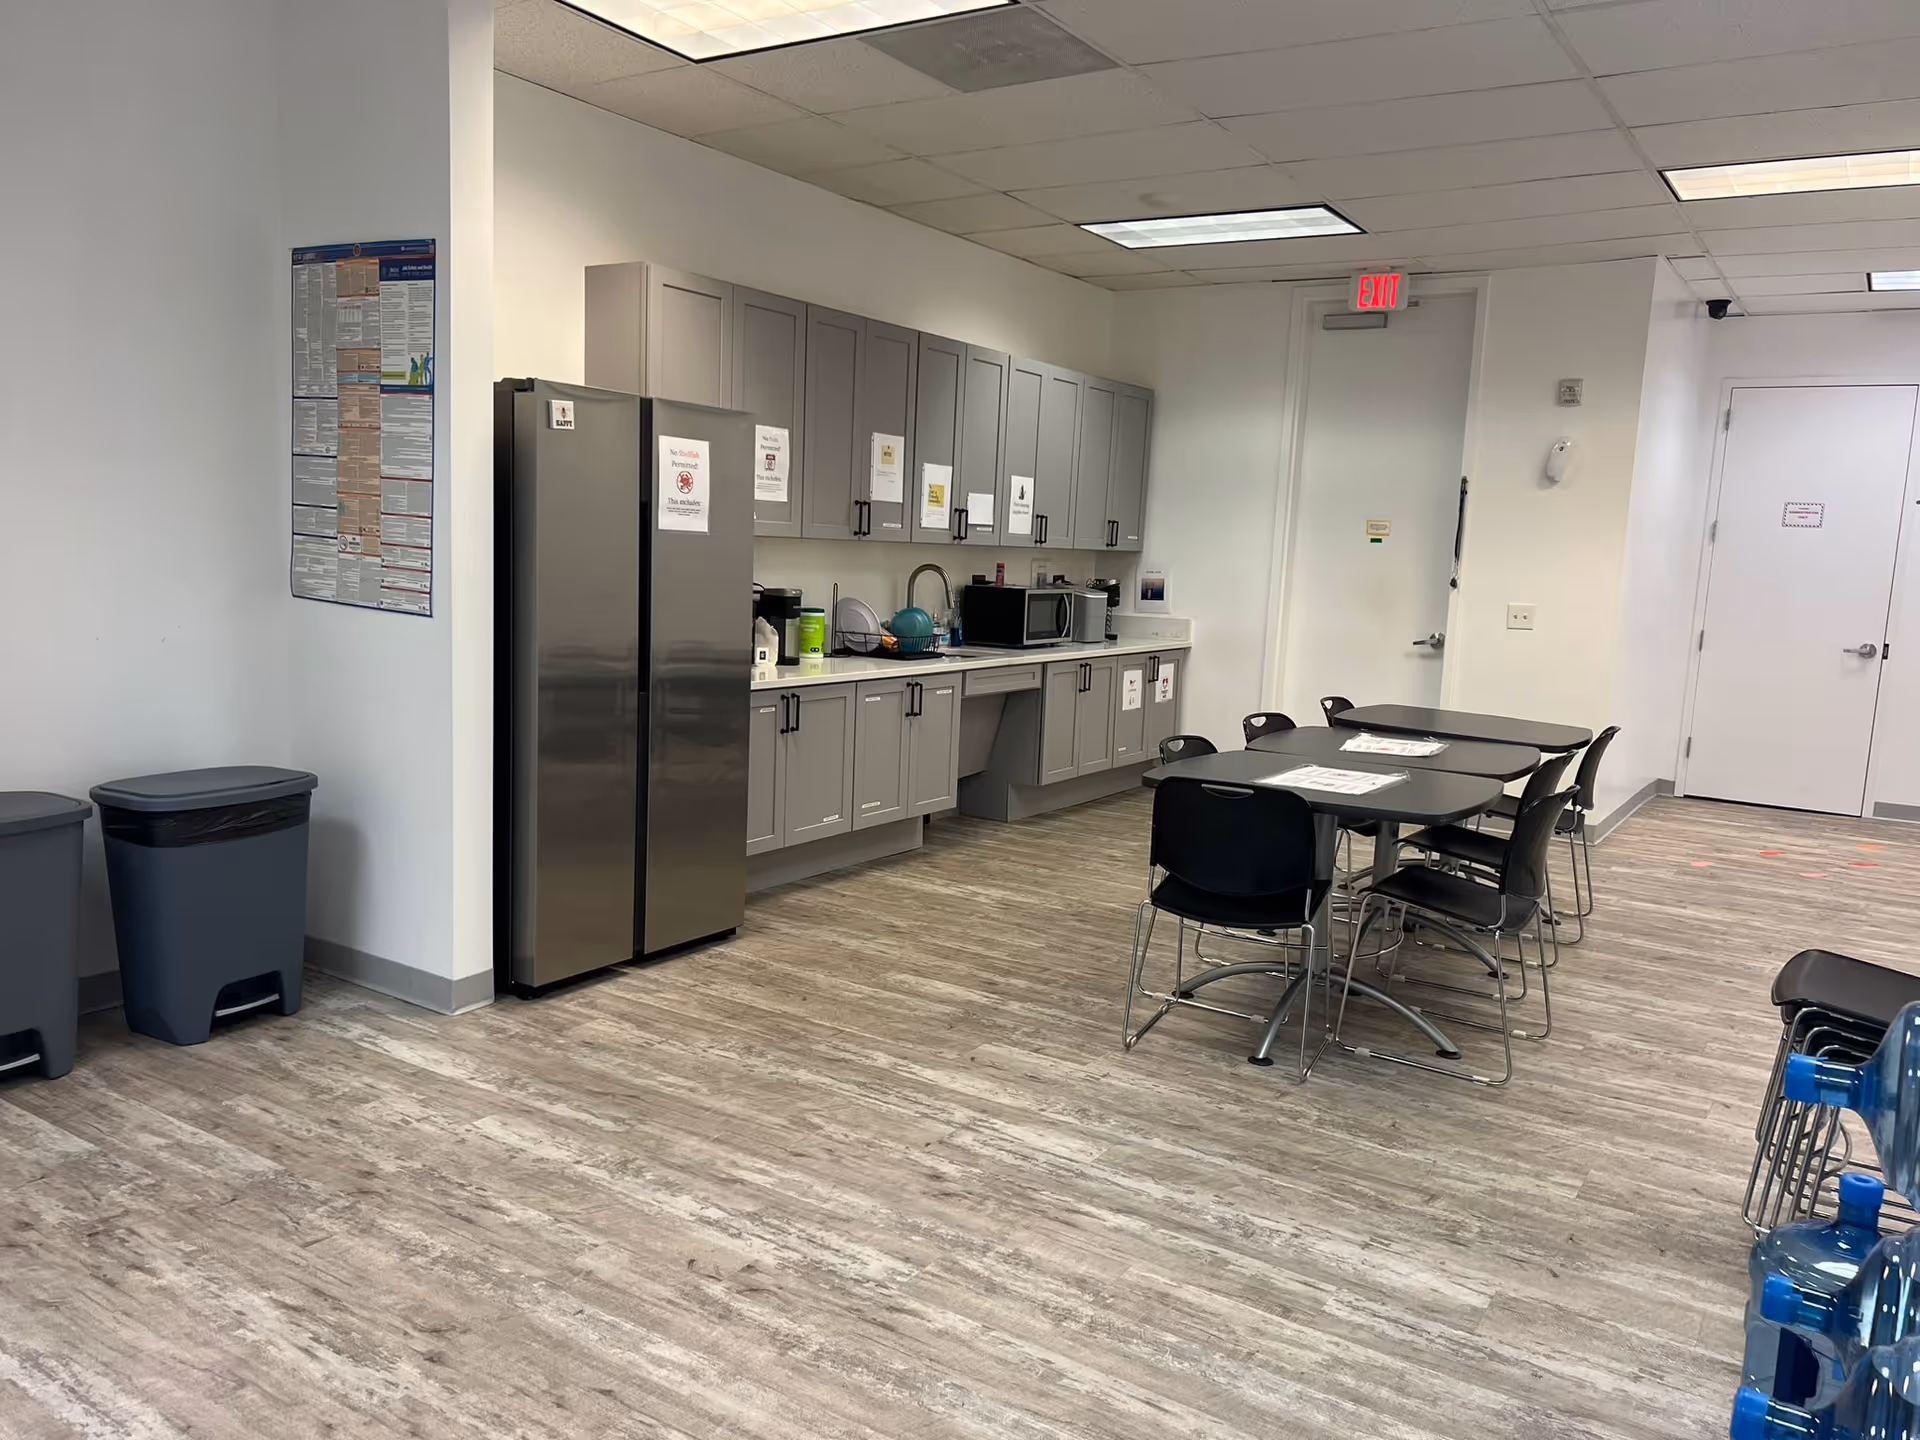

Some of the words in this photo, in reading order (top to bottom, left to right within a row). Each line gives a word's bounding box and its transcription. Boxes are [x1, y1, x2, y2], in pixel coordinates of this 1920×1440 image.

[1357, 273, 1401, 309] EXIT
[669, 448, 678, 456] No
[678, 450, 700, 458] Shellfish
[667, 497, 679, 505] This
